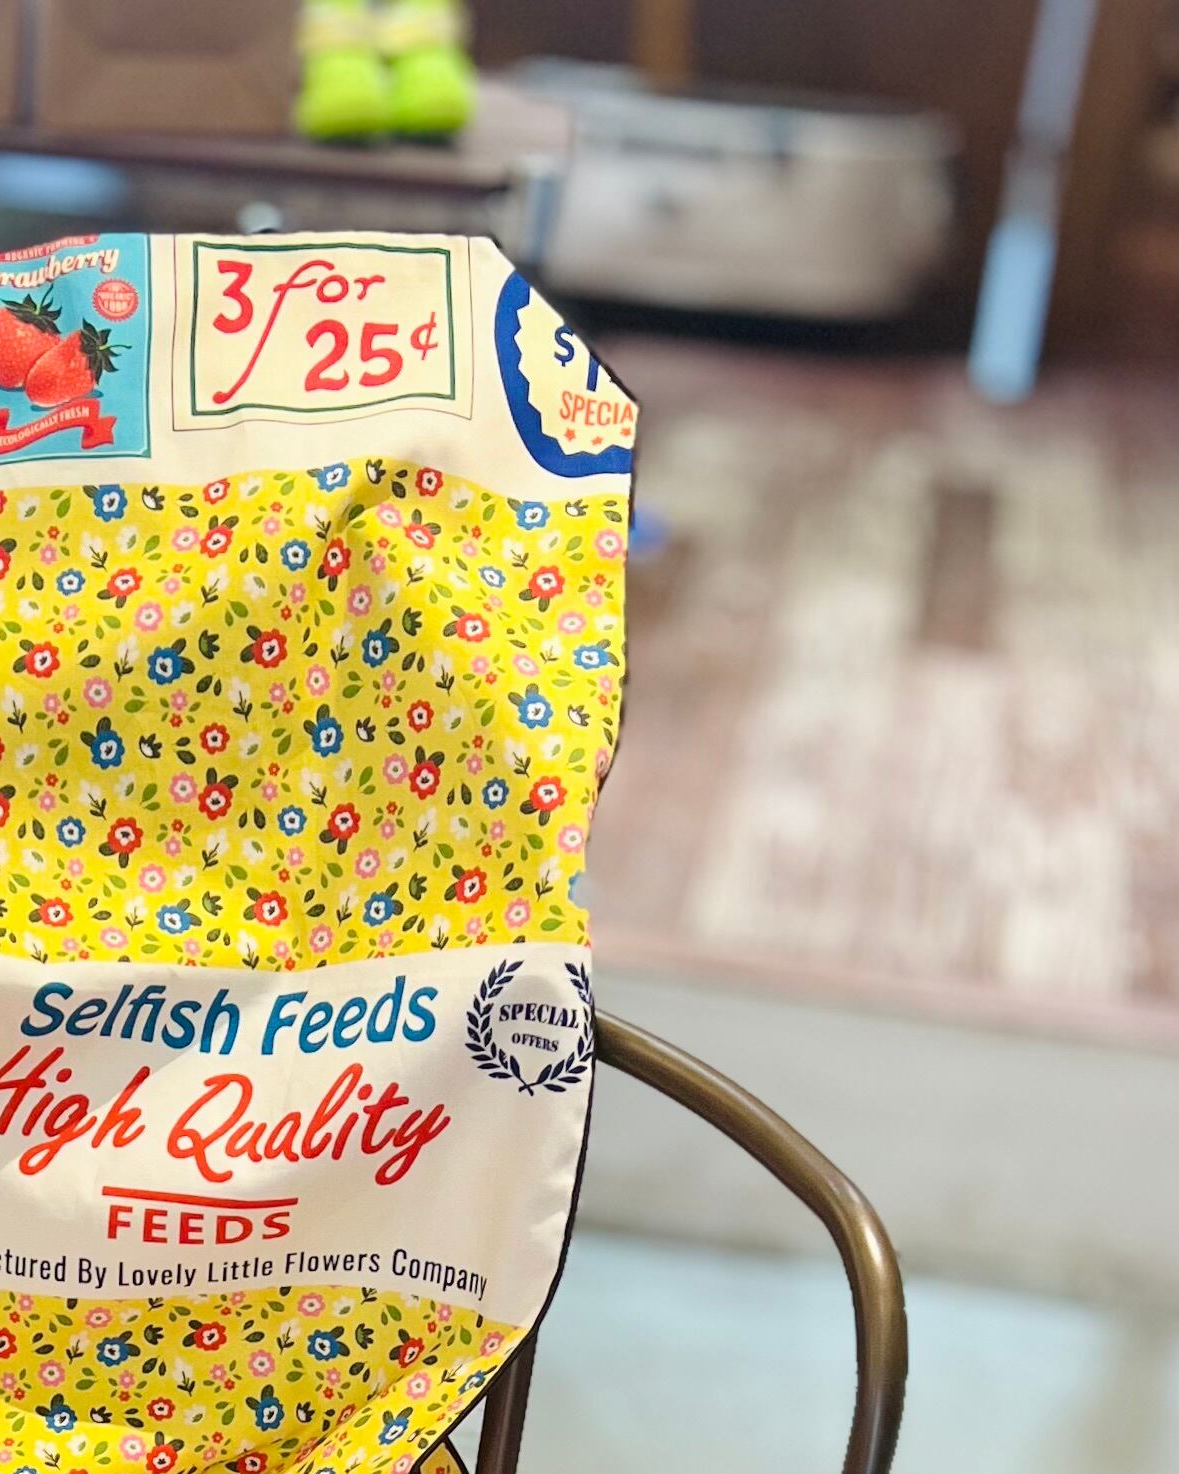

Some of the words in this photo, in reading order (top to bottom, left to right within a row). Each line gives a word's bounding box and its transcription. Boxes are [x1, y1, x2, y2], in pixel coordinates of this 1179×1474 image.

[213, 260, 254, 333] 3
[213, 259, 385, 404] for
[304, 311, 439, 392] 25¢
[60, 406, 90, 420] FRESH
[559, 390, 634, 426] SPECIA
[20, 982, 240, 1055] Selfish
[261, 975, 438, 1056] Feeds
[498, 1003, 579, 1029] SPECIAL
[511, 1032, 559, 1052] OFFERS
[167, 1062, 451, 1186] Quality
[106, 1204, 291, 1245] FEEDS
[78, 1258, 107, 1289] By
[119, 1261, 197, 1288] Lovely
[207, 1255, 273, 1283] Little
[285, 1248, 381, 1274] Flowers
[391, 1248, 488, 1301] Company
